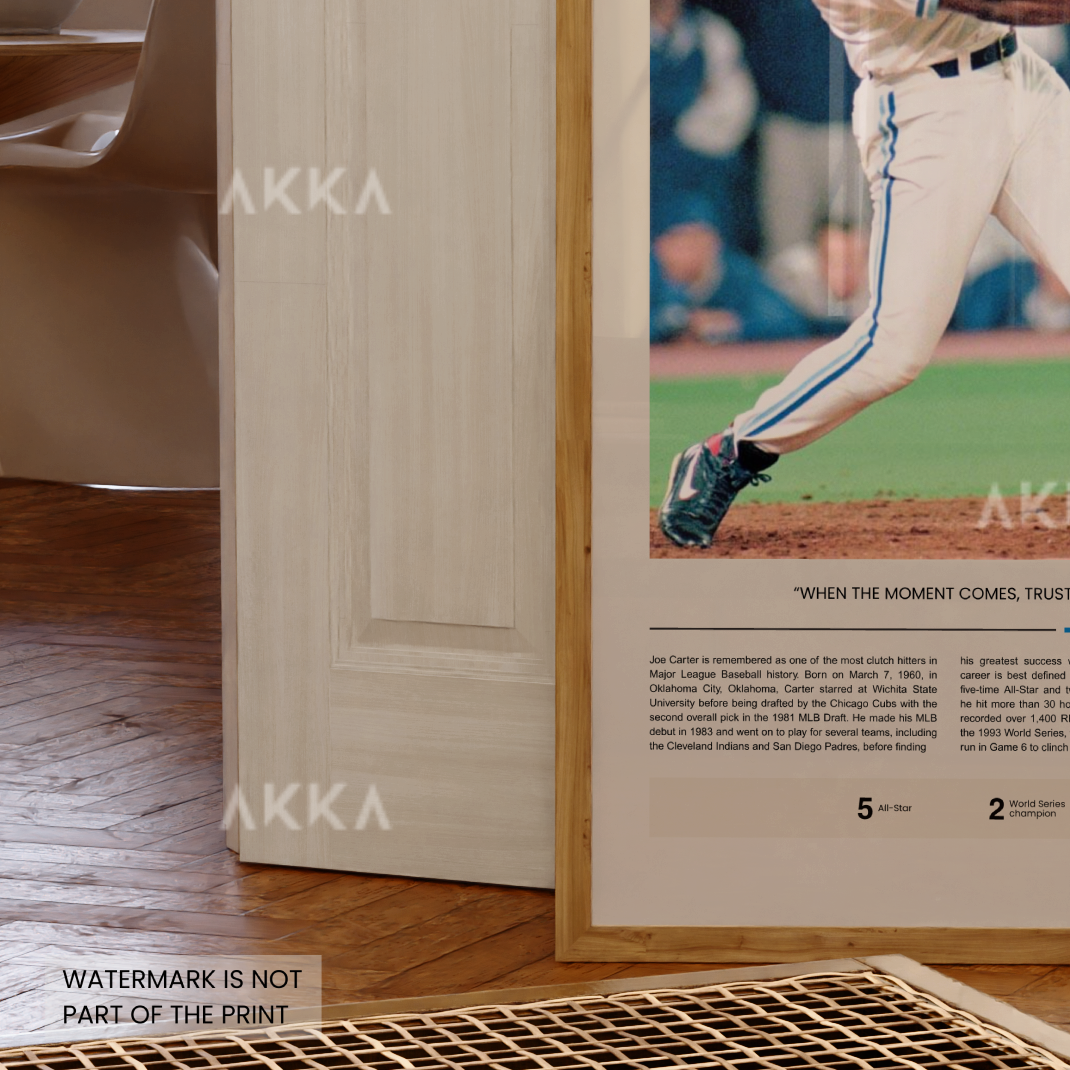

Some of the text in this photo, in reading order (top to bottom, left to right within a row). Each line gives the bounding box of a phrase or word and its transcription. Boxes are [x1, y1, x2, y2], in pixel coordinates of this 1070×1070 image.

[794, 586, 846, 600] “WHEN
[852, 586, 879, 600] THE
[885, 587, 954, 600] MOMENT
[959, 587, 1020, 602] COMES,
[649, 655, 937, 665] Joe Carter is remembered as one of the most clutch hitters in
[960, 672, 991, 680] career
[994, 670, 1003, 680] is
[1007, 671, 1027, 680] best
[1031, 670, 1066, 680] defined
[649, 741, 926, 753] the Cleveland Indians and San Diego Padres, before finding
[857, 797, 912, 820] 5 All-Star
[989, 797, 1004, 820] 2
[1009, 799, 1066, 808] World Series
[1009, 809, 1057, 820] champion
